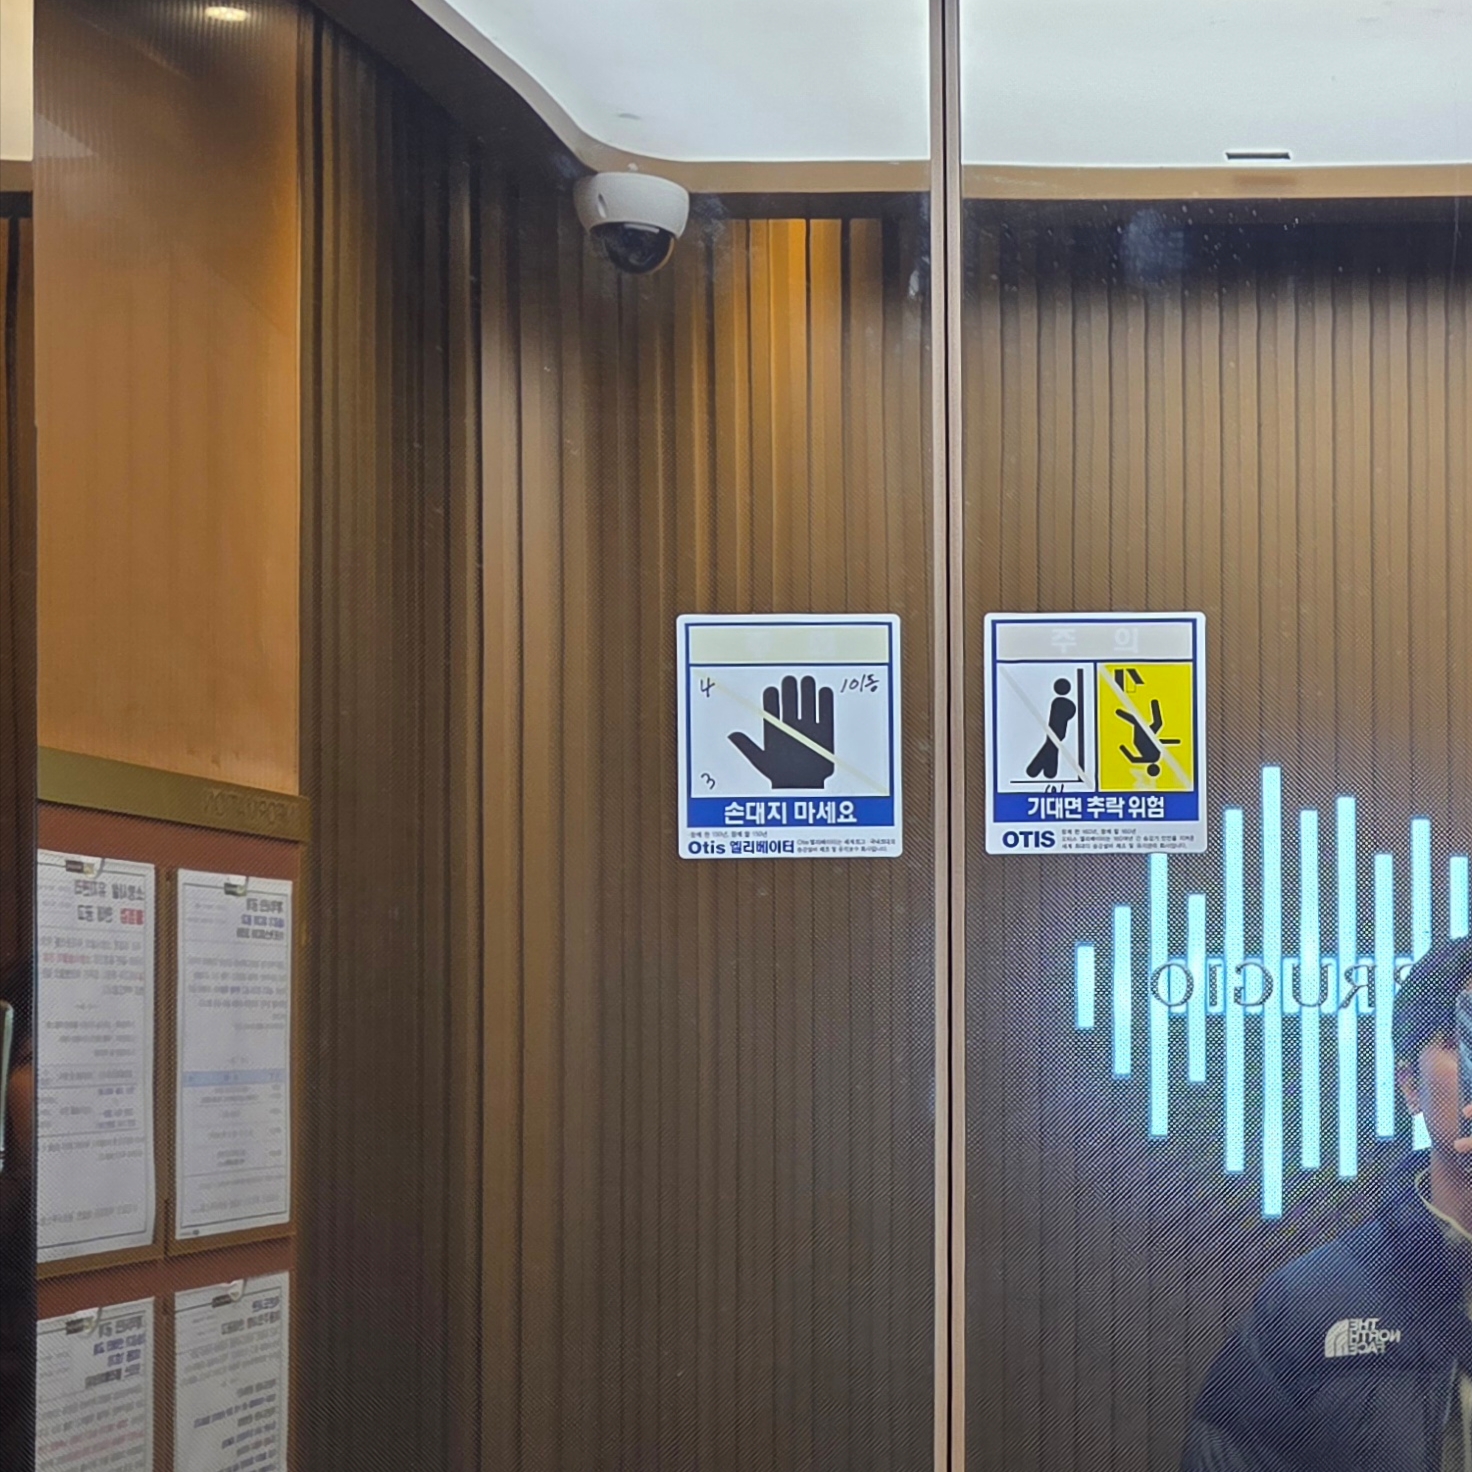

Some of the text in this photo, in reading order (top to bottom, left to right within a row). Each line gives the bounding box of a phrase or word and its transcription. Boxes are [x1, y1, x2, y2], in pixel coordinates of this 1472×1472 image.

[724, 801, 857, 825] 손대지 마세요
[1027, 796, 1164, 819] 기대면 추락 위험
[688, 840, 794, 854] Otis 엘리베이터
[1002, 831, 1055, 847] OTIS
